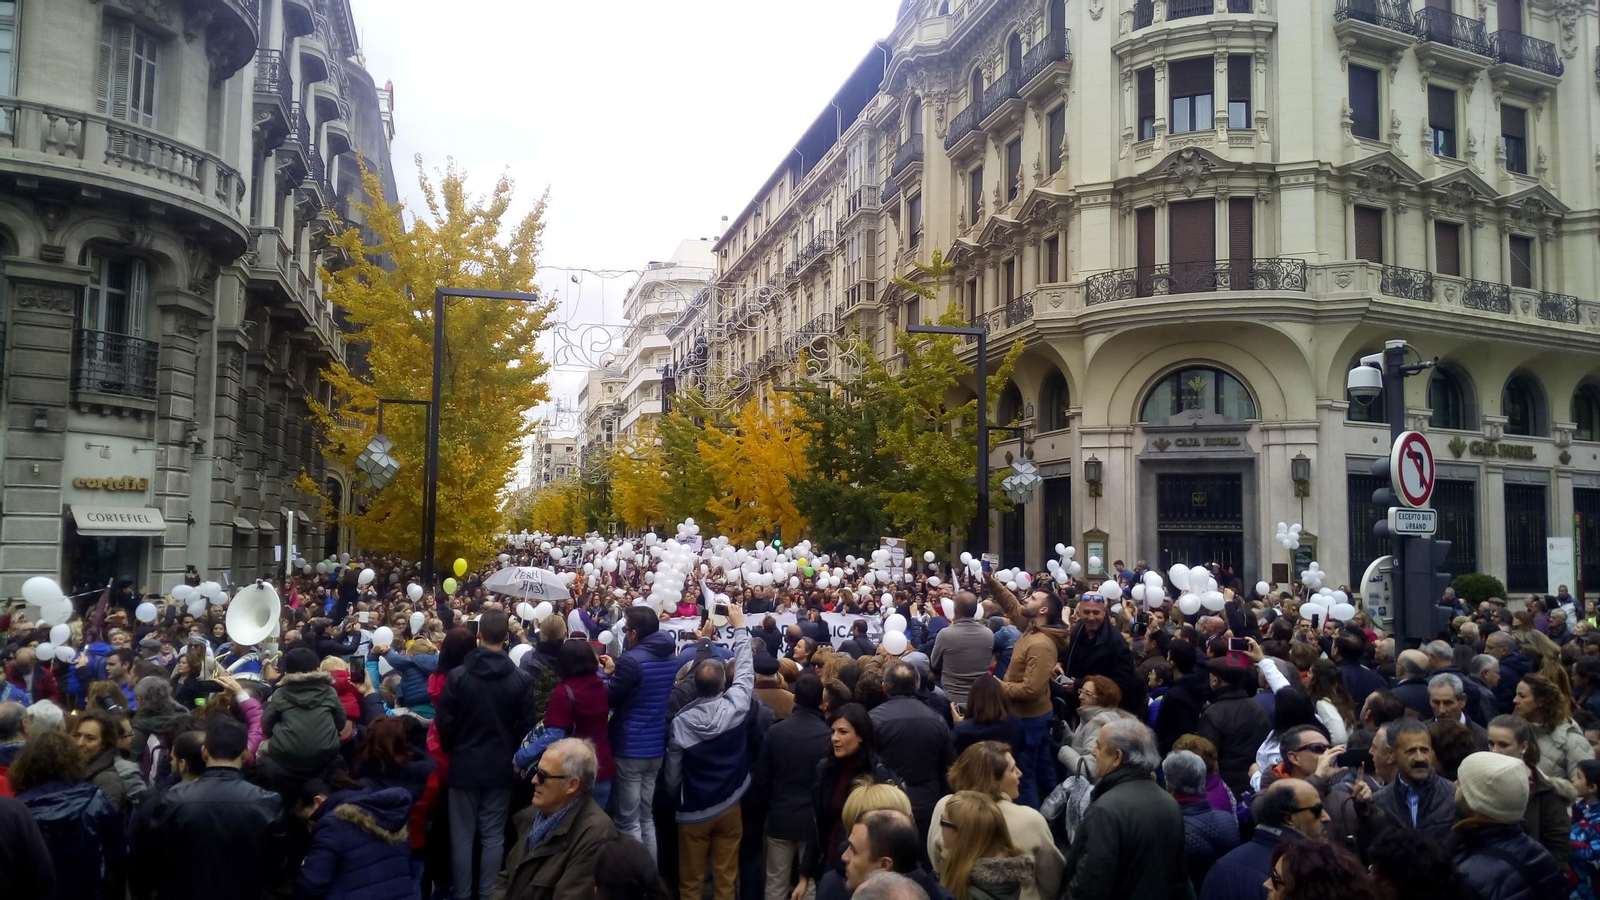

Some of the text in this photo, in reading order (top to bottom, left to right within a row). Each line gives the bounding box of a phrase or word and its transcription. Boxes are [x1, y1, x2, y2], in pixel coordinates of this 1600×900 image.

[72, 475, 149, 492] cortefiel
[86, 512, 152, 523] CORTEFIEL
[1405, 522, 1427, 530] URBANO
